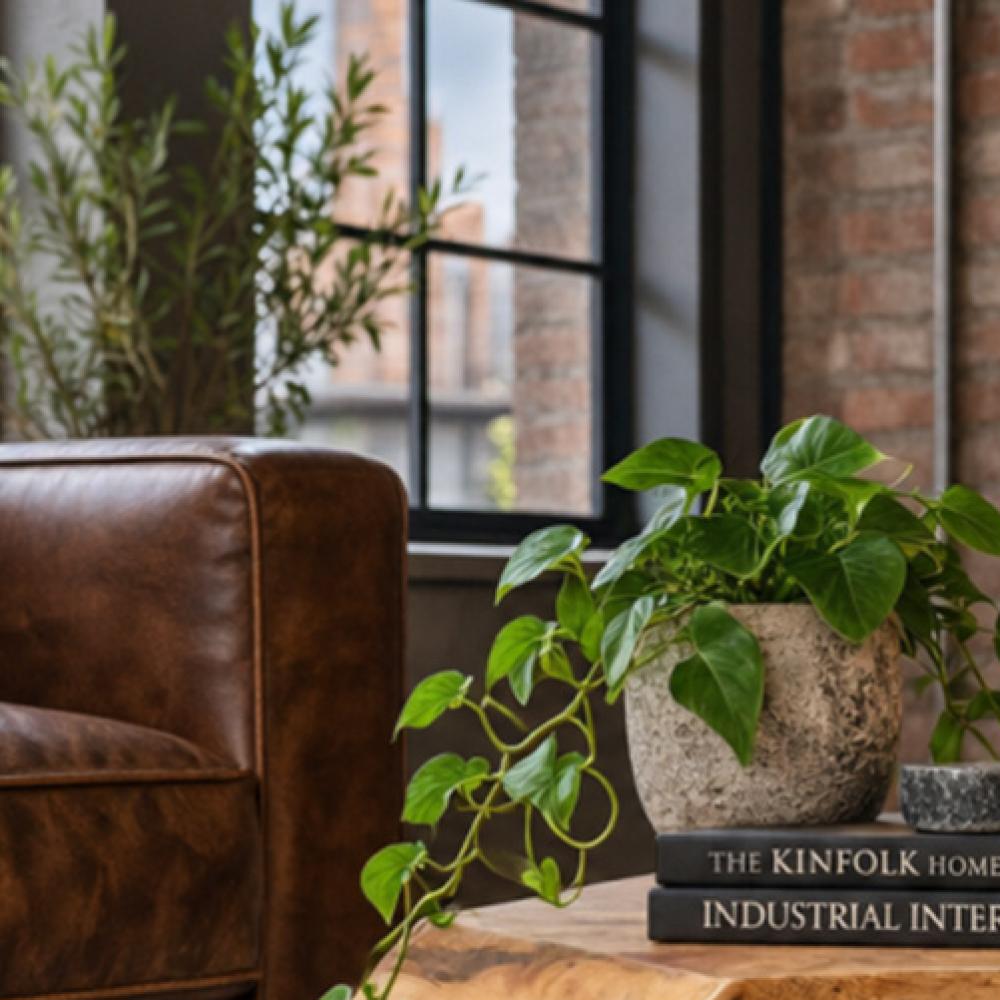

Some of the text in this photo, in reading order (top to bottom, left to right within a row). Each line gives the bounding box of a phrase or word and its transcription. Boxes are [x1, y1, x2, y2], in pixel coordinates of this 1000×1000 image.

[708, 851, 761, 873] THE
[772, 848, 919, 877] KINFOLK
[703, 899, 901, 931] INDUSTRIAL
